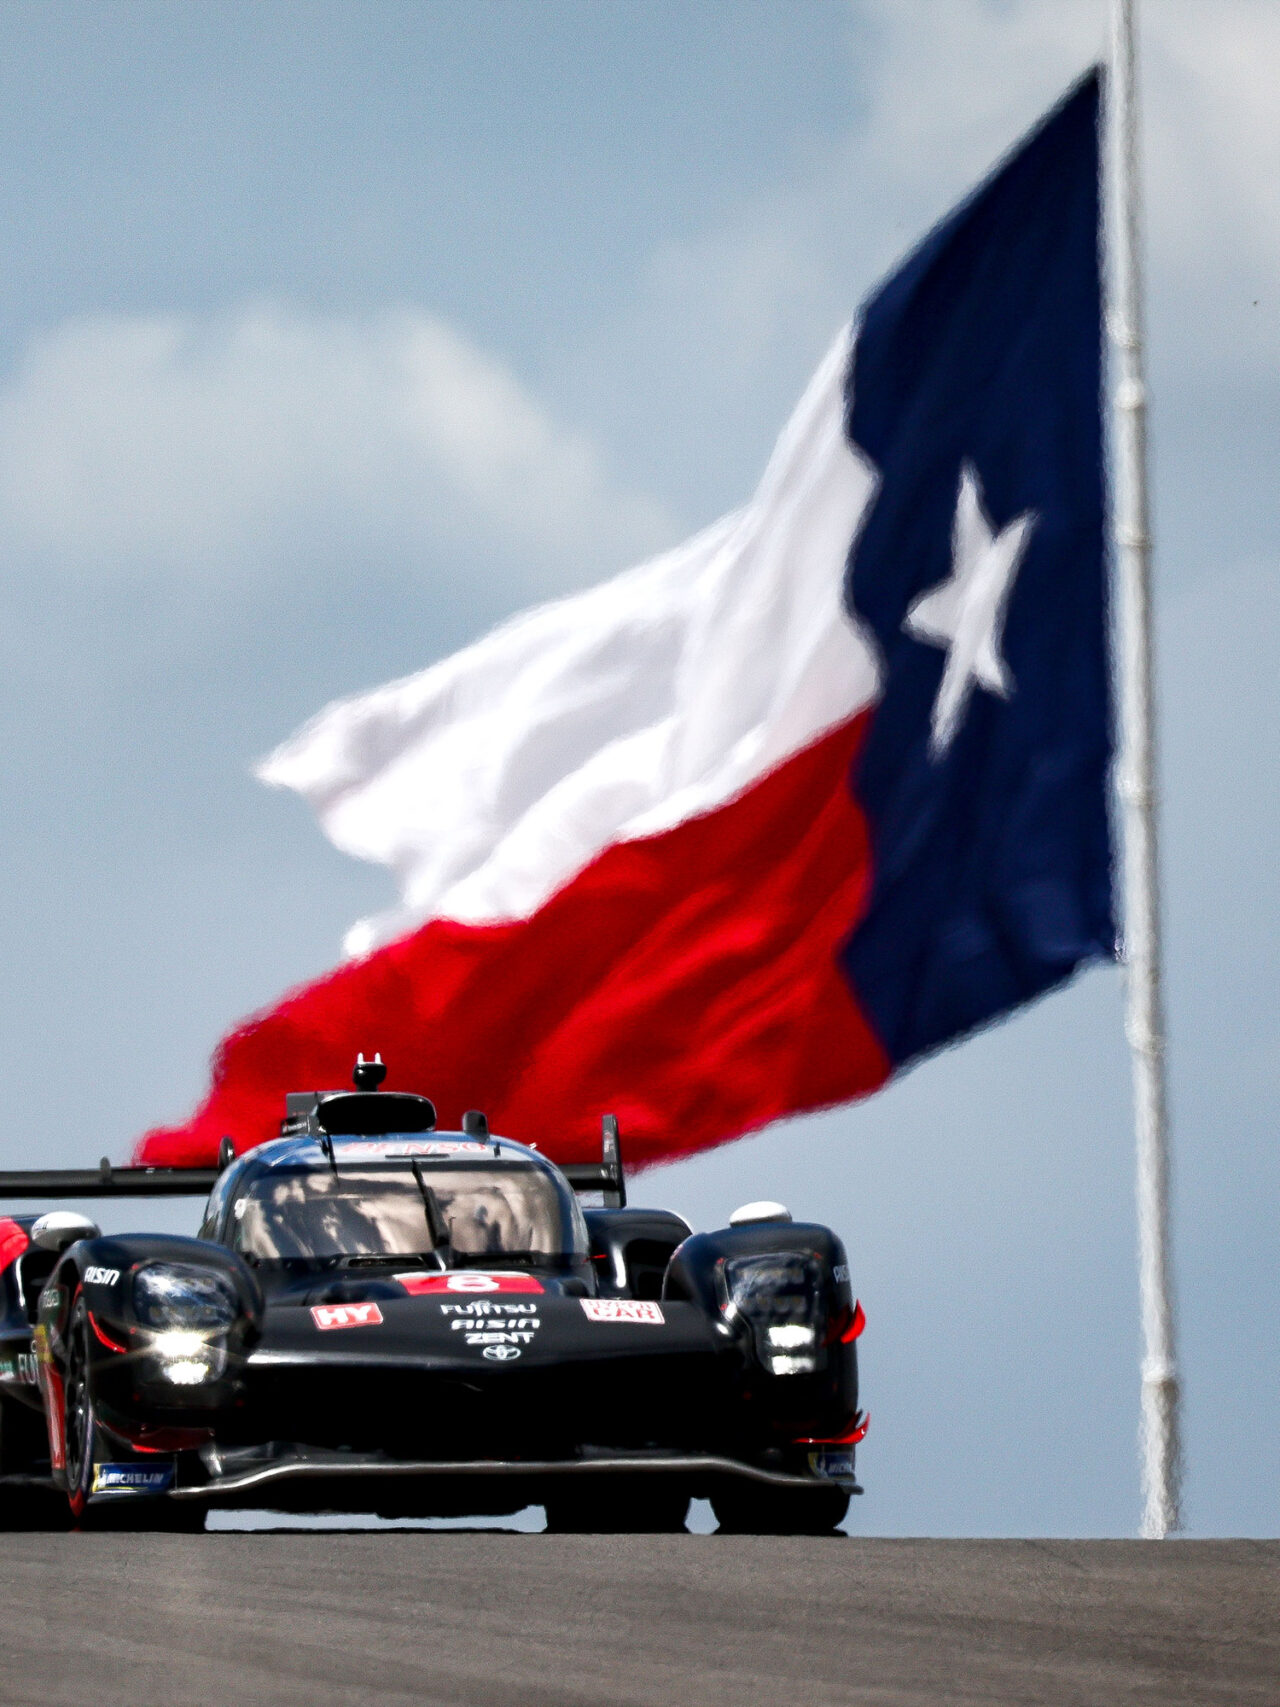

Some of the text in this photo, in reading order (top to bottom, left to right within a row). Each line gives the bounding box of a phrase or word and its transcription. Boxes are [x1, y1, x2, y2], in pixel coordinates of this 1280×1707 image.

[84, 1266, 120, 1286] AISIN
[446, 1275, 500, 1293] 8
[317, 1305, 372, 1325] HY
[440, 1300, 537, 1316] FUJITSU
[592, 1307, 656, 1319] CAR
[451, 1318, 540, 1330] AISIN
[464, 1332, 535, 1344] ZENT
[106, 1472, 164, 1484] MICHELIN
